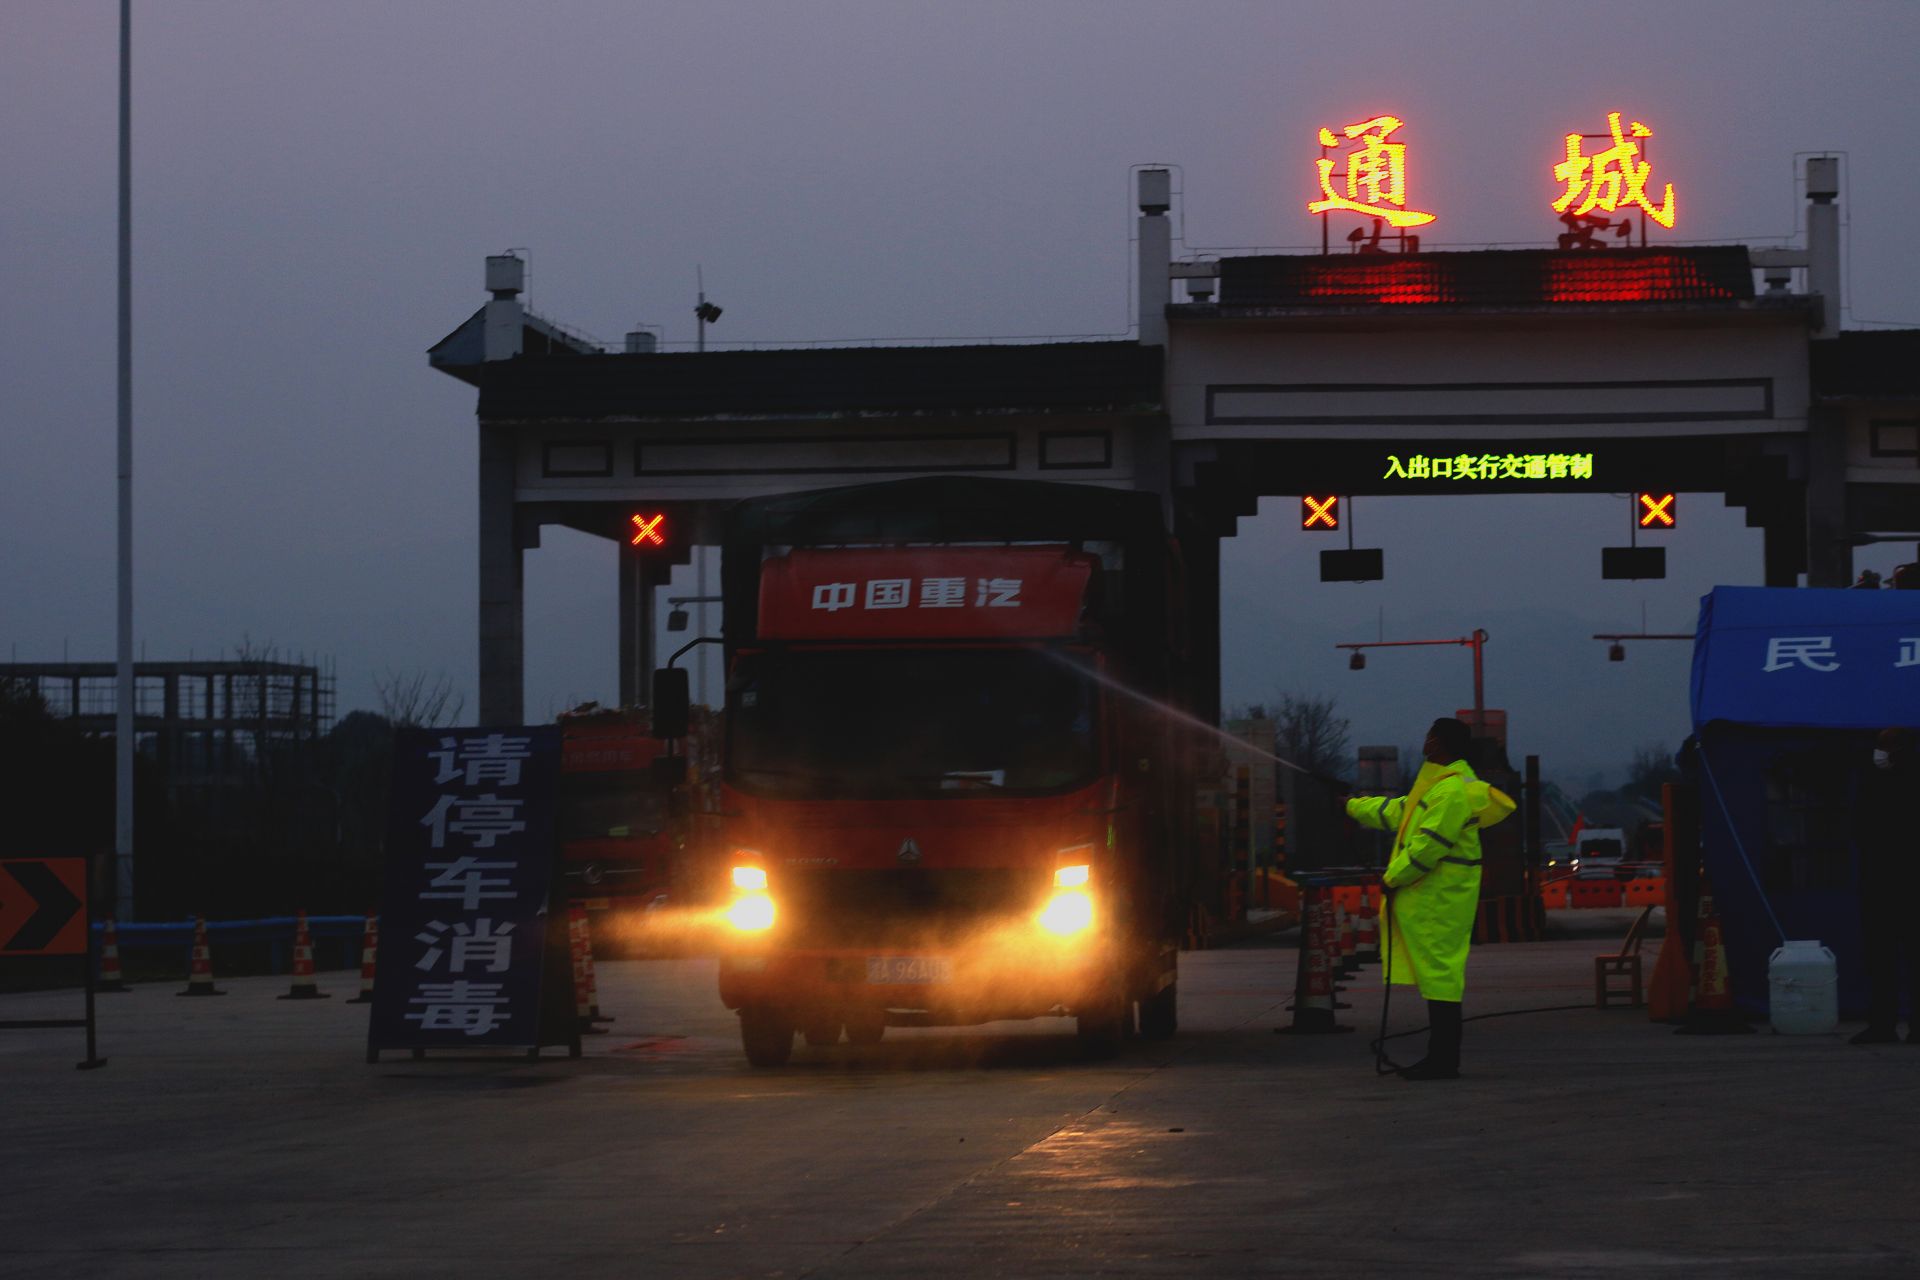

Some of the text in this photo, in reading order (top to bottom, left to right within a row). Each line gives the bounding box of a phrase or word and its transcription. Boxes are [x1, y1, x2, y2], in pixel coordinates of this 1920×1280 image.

[1307, 112, 1676, 228] 通城
[1383, 453, 1593, 480] 入出口实行交通管制
[812, 577, 1023, 612] 中国重汽
[404, 734, 532, 1036] 请停车消毒
